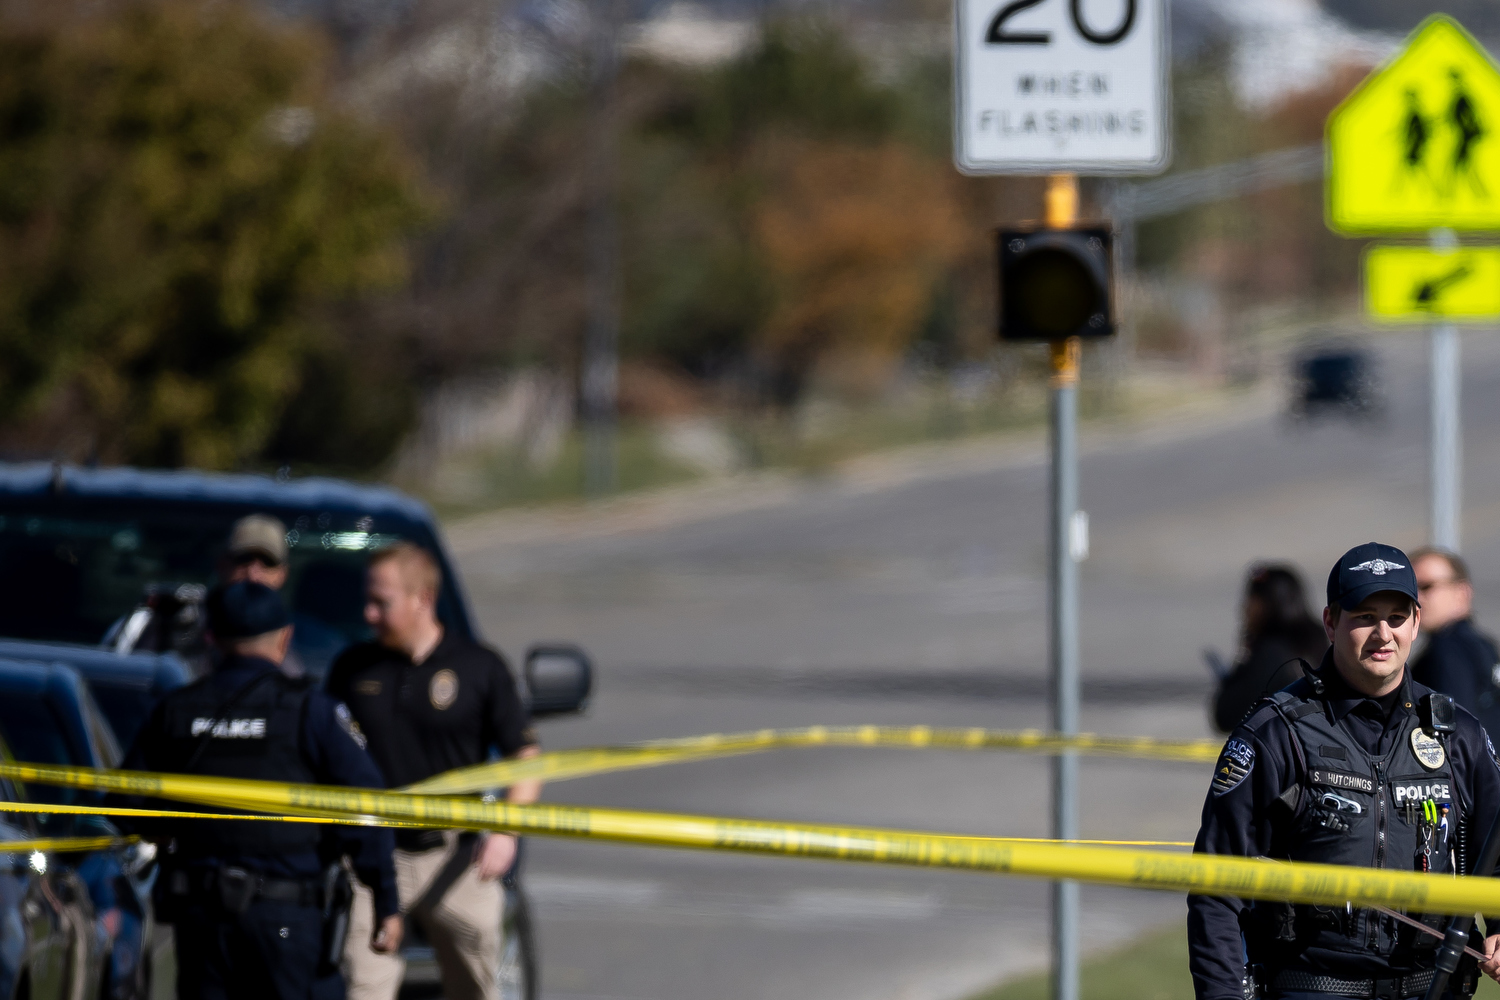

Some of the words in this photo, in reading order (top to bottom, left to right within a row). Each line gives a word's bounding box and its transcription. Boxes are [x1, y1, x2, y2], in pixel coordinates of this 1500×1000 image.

[1017, 71, 1110, 95] WHEN
[978, 108, 1146, 135] FLASHING
[1227, 740, 1253, 762] OLICE
[1314, 771, 1322, 783] S.
[1326, 772, 1373, 791] HUTCHINGS
[1395, 784, 1450, 801] POLICE
